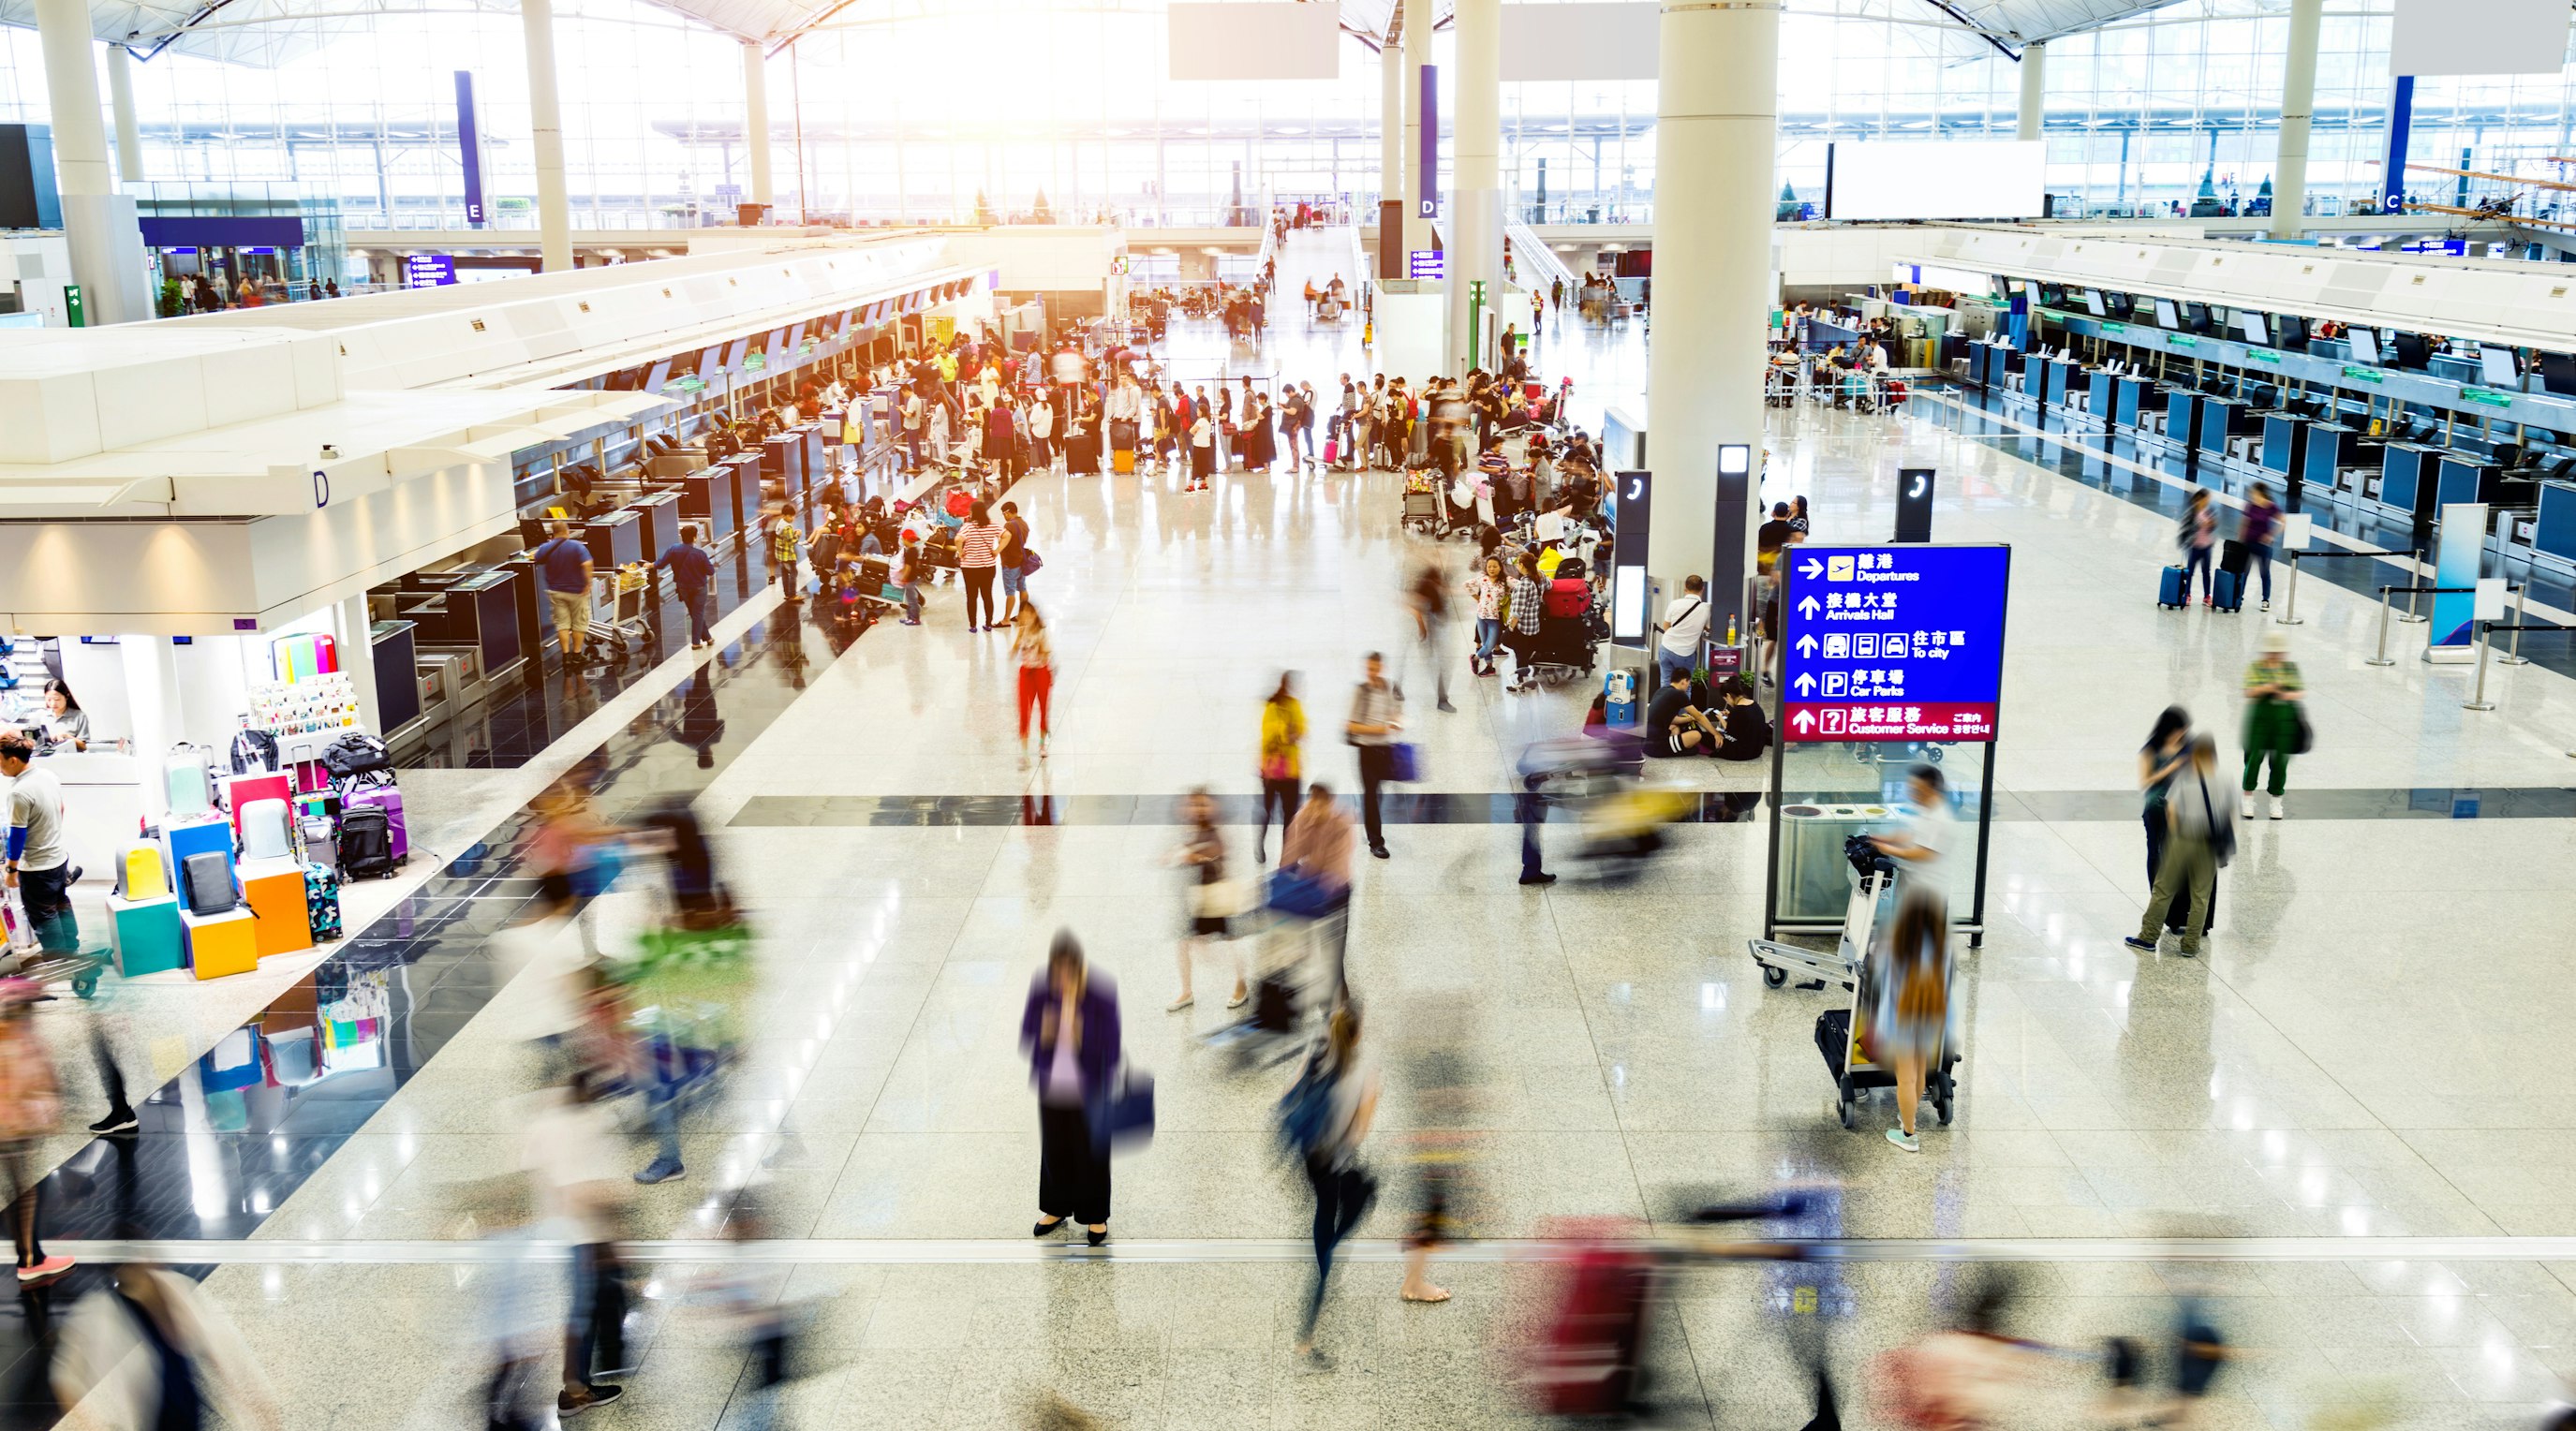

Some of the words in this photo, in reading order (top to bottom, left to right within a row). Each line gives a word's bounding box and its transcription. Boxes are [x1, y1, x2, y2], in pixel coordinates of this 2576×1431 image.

[1422, 200, 1434, 214] D
[2386, 195, 2399, 209] C
[469, 204, 481, 218] E
[314, 470, 329, 509] D
[1858, 553, 1893, 569] 離港
[1857, 570, 1919, 583] Departures
[1826, 592, 1897, 608] 接機大堂
[1825, 609, 1871, 620] Arrivals
[1871, 609, 1895, 620] Hall
[1912, 630, 1965, 646] 往市區
[1911, 646, 1927, 658] To
[1928, 647, 1949, 660] city
[1827, 674, 1844, 694] P
[1852, 669, 1904, 685] 停車場
[1850, 686, 1872, 697] Car
[1873, 686, 1904, 697] Parks
[1849, 706, 1921, 722] 旅客服務
[1848, 723, 1904, 734] Customer
[1906, 723, 1949, 734] Service
